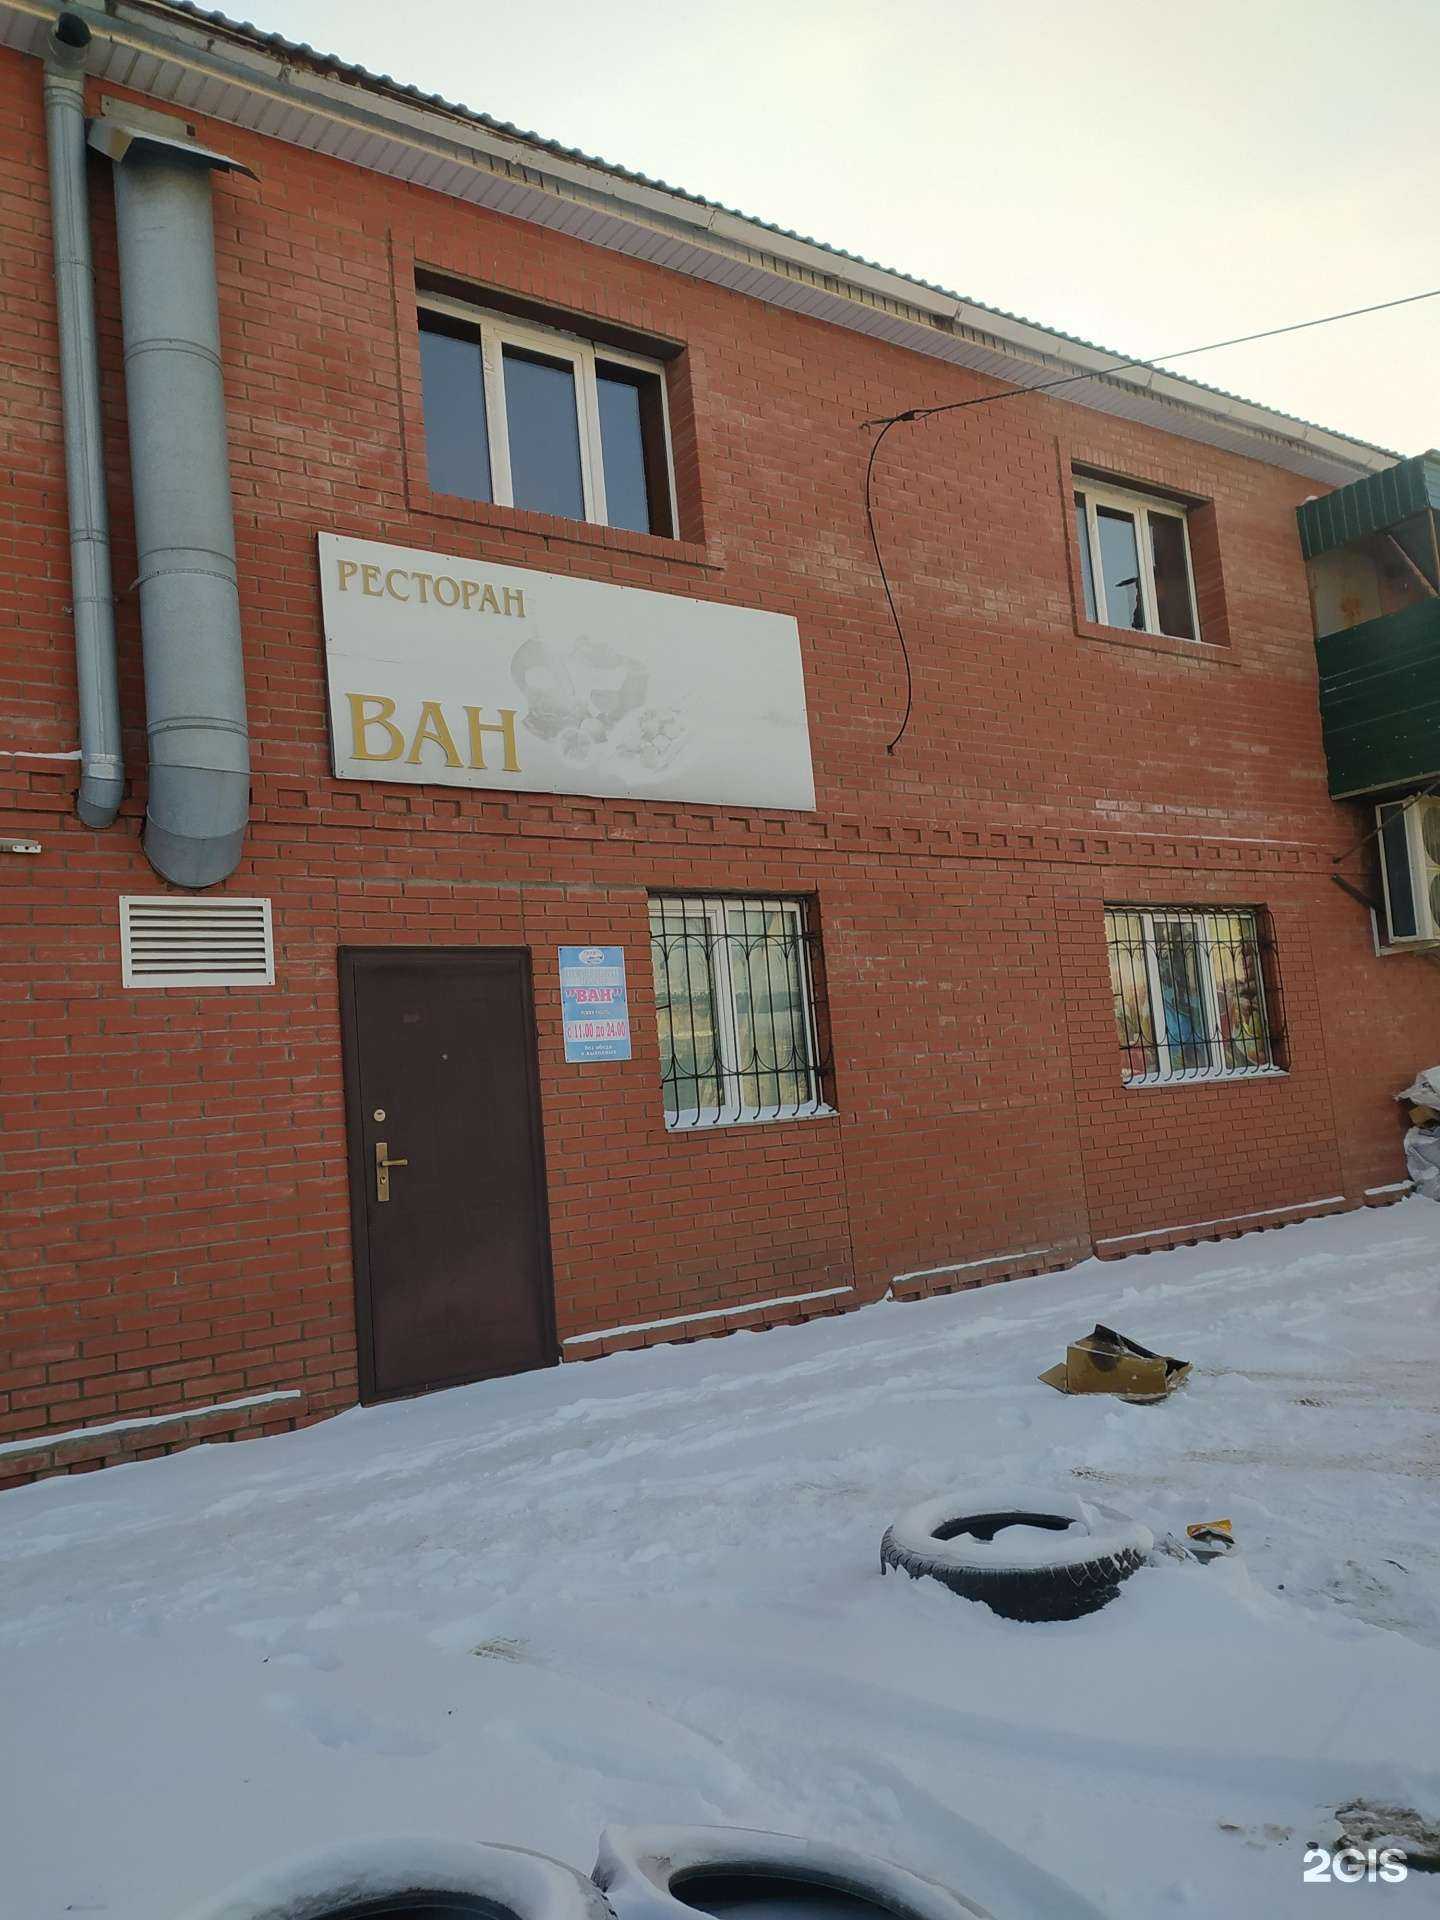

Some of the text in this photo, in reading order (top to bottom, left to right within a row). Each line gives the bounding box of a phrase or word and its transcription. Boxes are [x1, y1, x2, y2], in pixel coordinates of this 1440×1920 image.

[336, 559, 526, 618] РЕСТОРАН
[345, 692, 523, 773] ВАН
[575, 1024, 594, 1038] 11.00
[596, 1026, 605, 1038] до
[607, 1022, 626, 1037] 24.00
